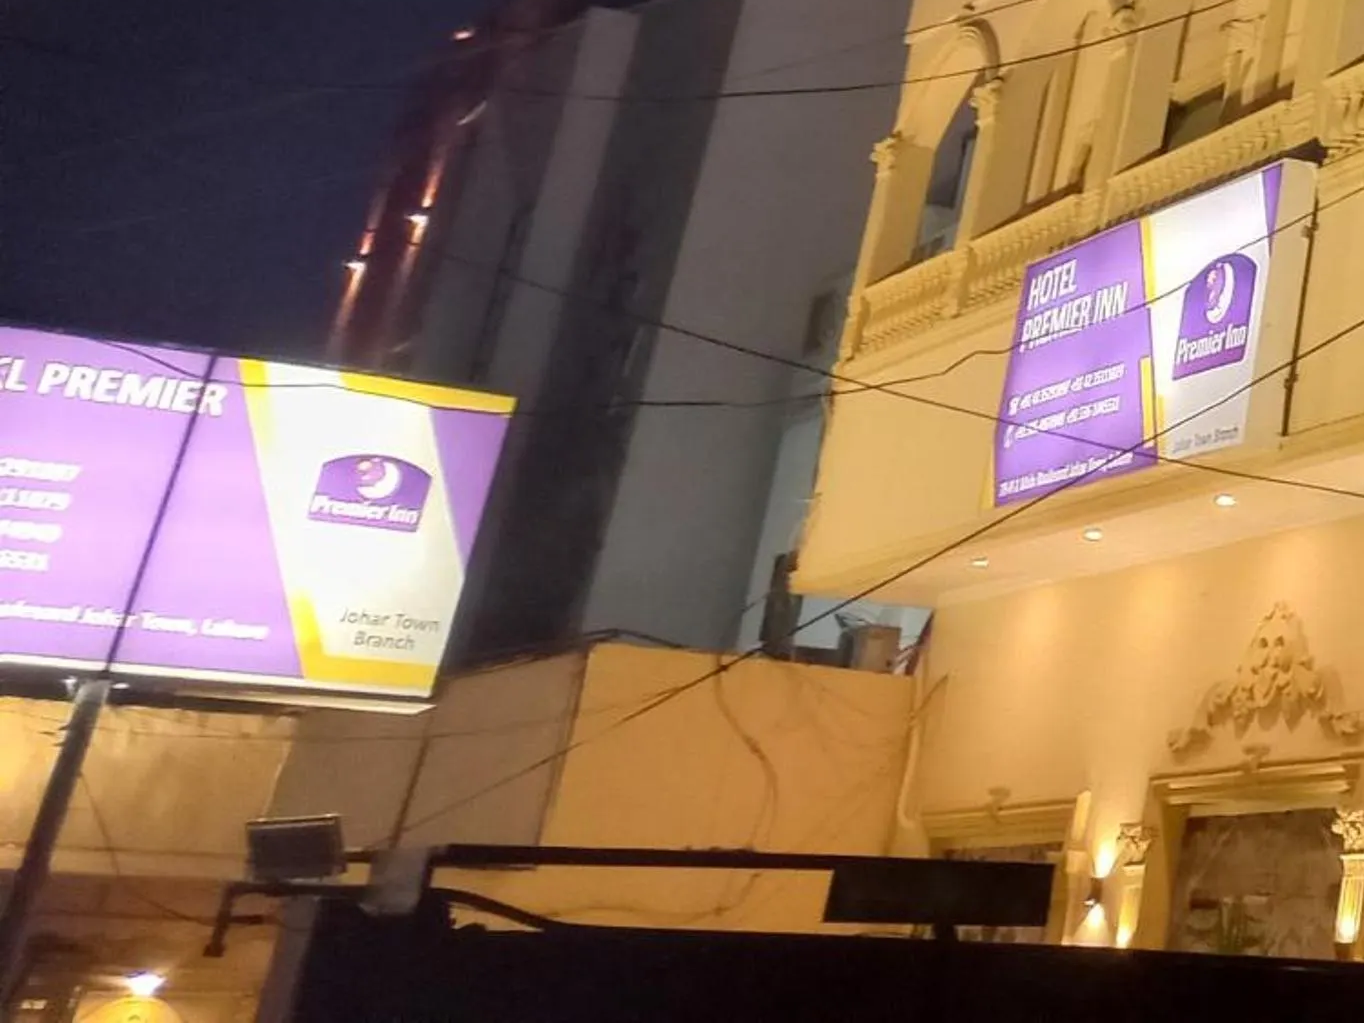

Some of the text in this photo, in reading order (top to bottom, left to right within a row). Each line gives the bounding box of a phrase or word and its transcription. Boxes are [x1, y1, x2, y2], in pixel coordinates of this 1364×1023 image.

[1027, 259, 1078, 310] HOTEL
[1020, 281, 1129, 352] PREMIER INN
[1176, 323, 1247, 364] Premier Inn
[37, 361, 229, 416] PREMIER
[310, 495, 419, 524] Premier Inn
[339, 606, 440, 632] Johar Town
[353, 630, 416, 650] Branch
